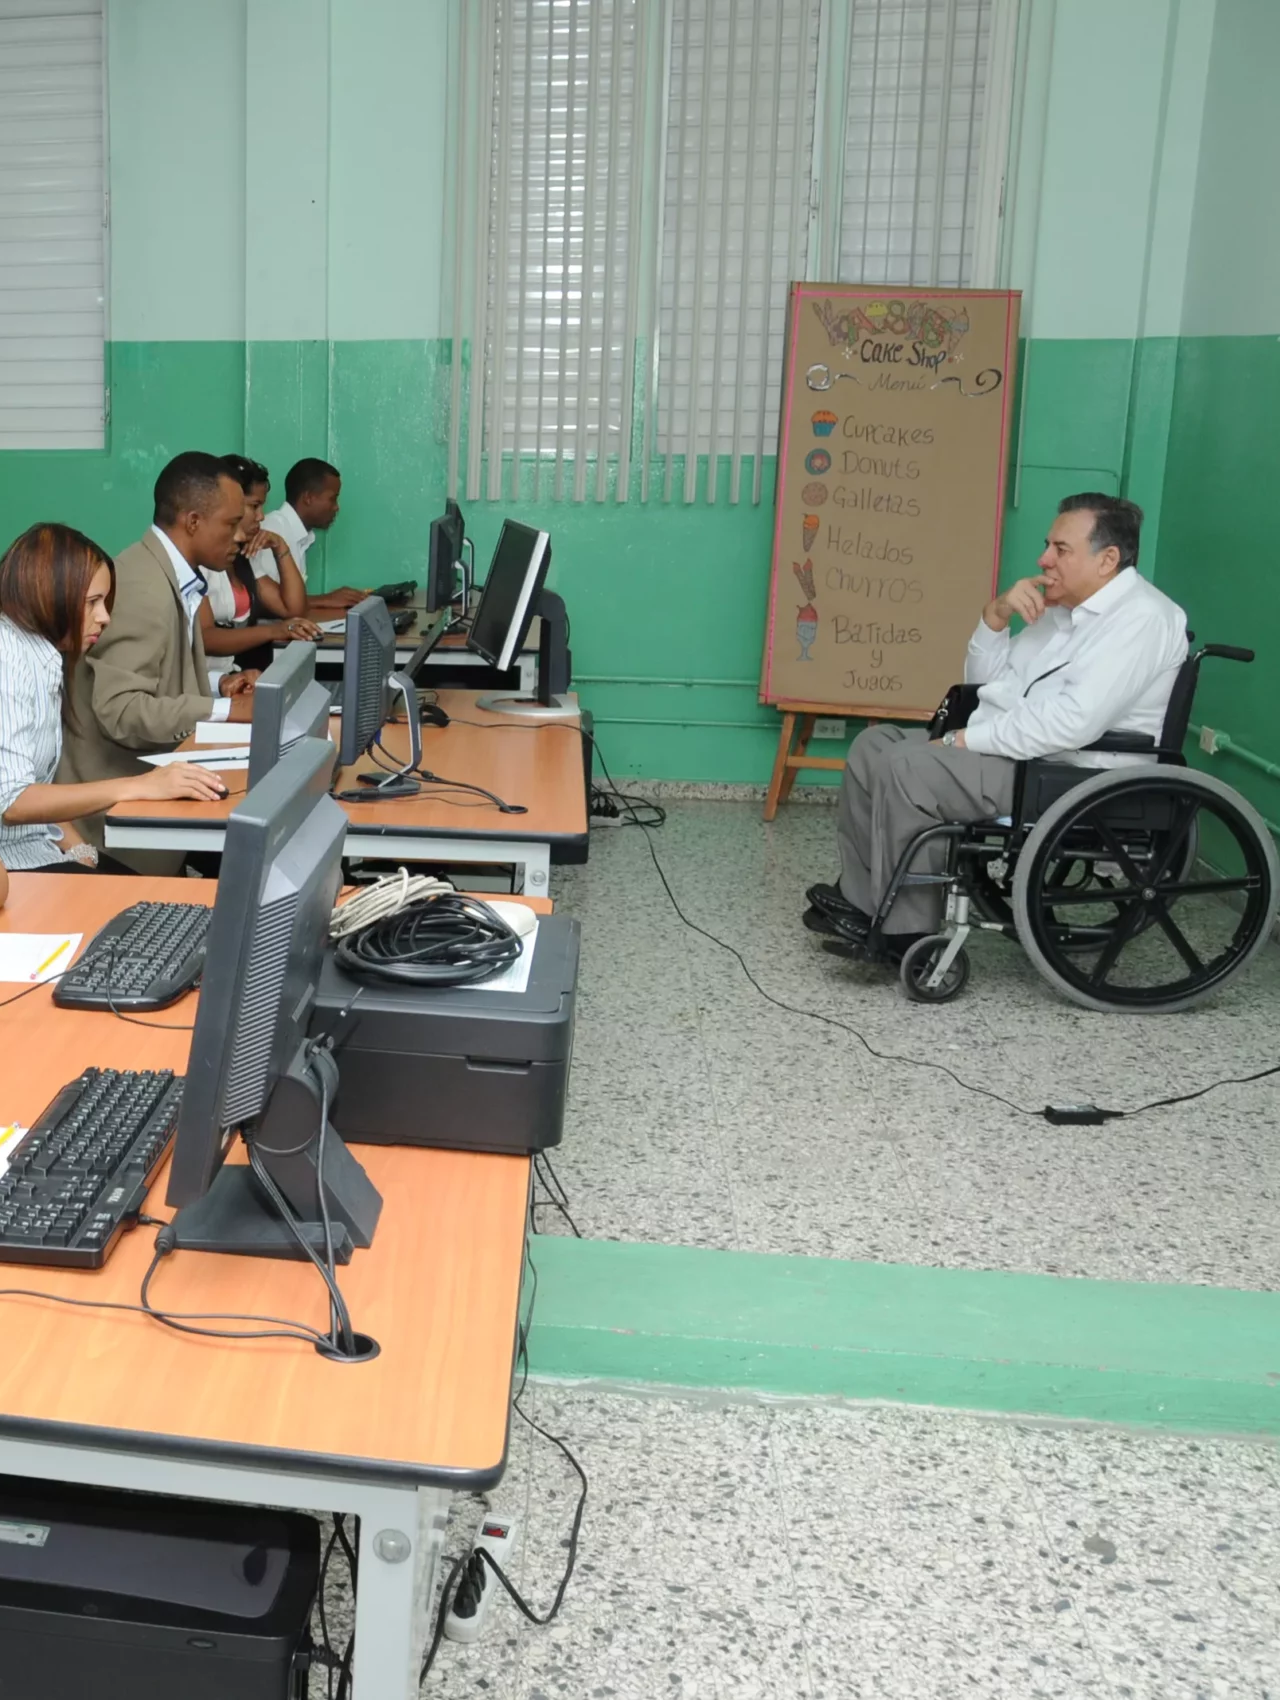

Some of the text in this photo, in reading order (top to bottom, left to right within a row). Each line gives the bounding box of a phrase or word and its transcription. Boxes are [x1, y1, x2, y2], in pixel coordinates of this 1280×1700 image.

[860, 339, 947, 374] Cake Shop
[842, 414, 935, 446] Cupcakes
[838, 450, 920, 480] Donuts
[832, 485, 921, 517] Galletas
[826, 524, 913, 565] Helados
[825, 566, 924, 604] Churros
[870, 649, 883, 669] y
